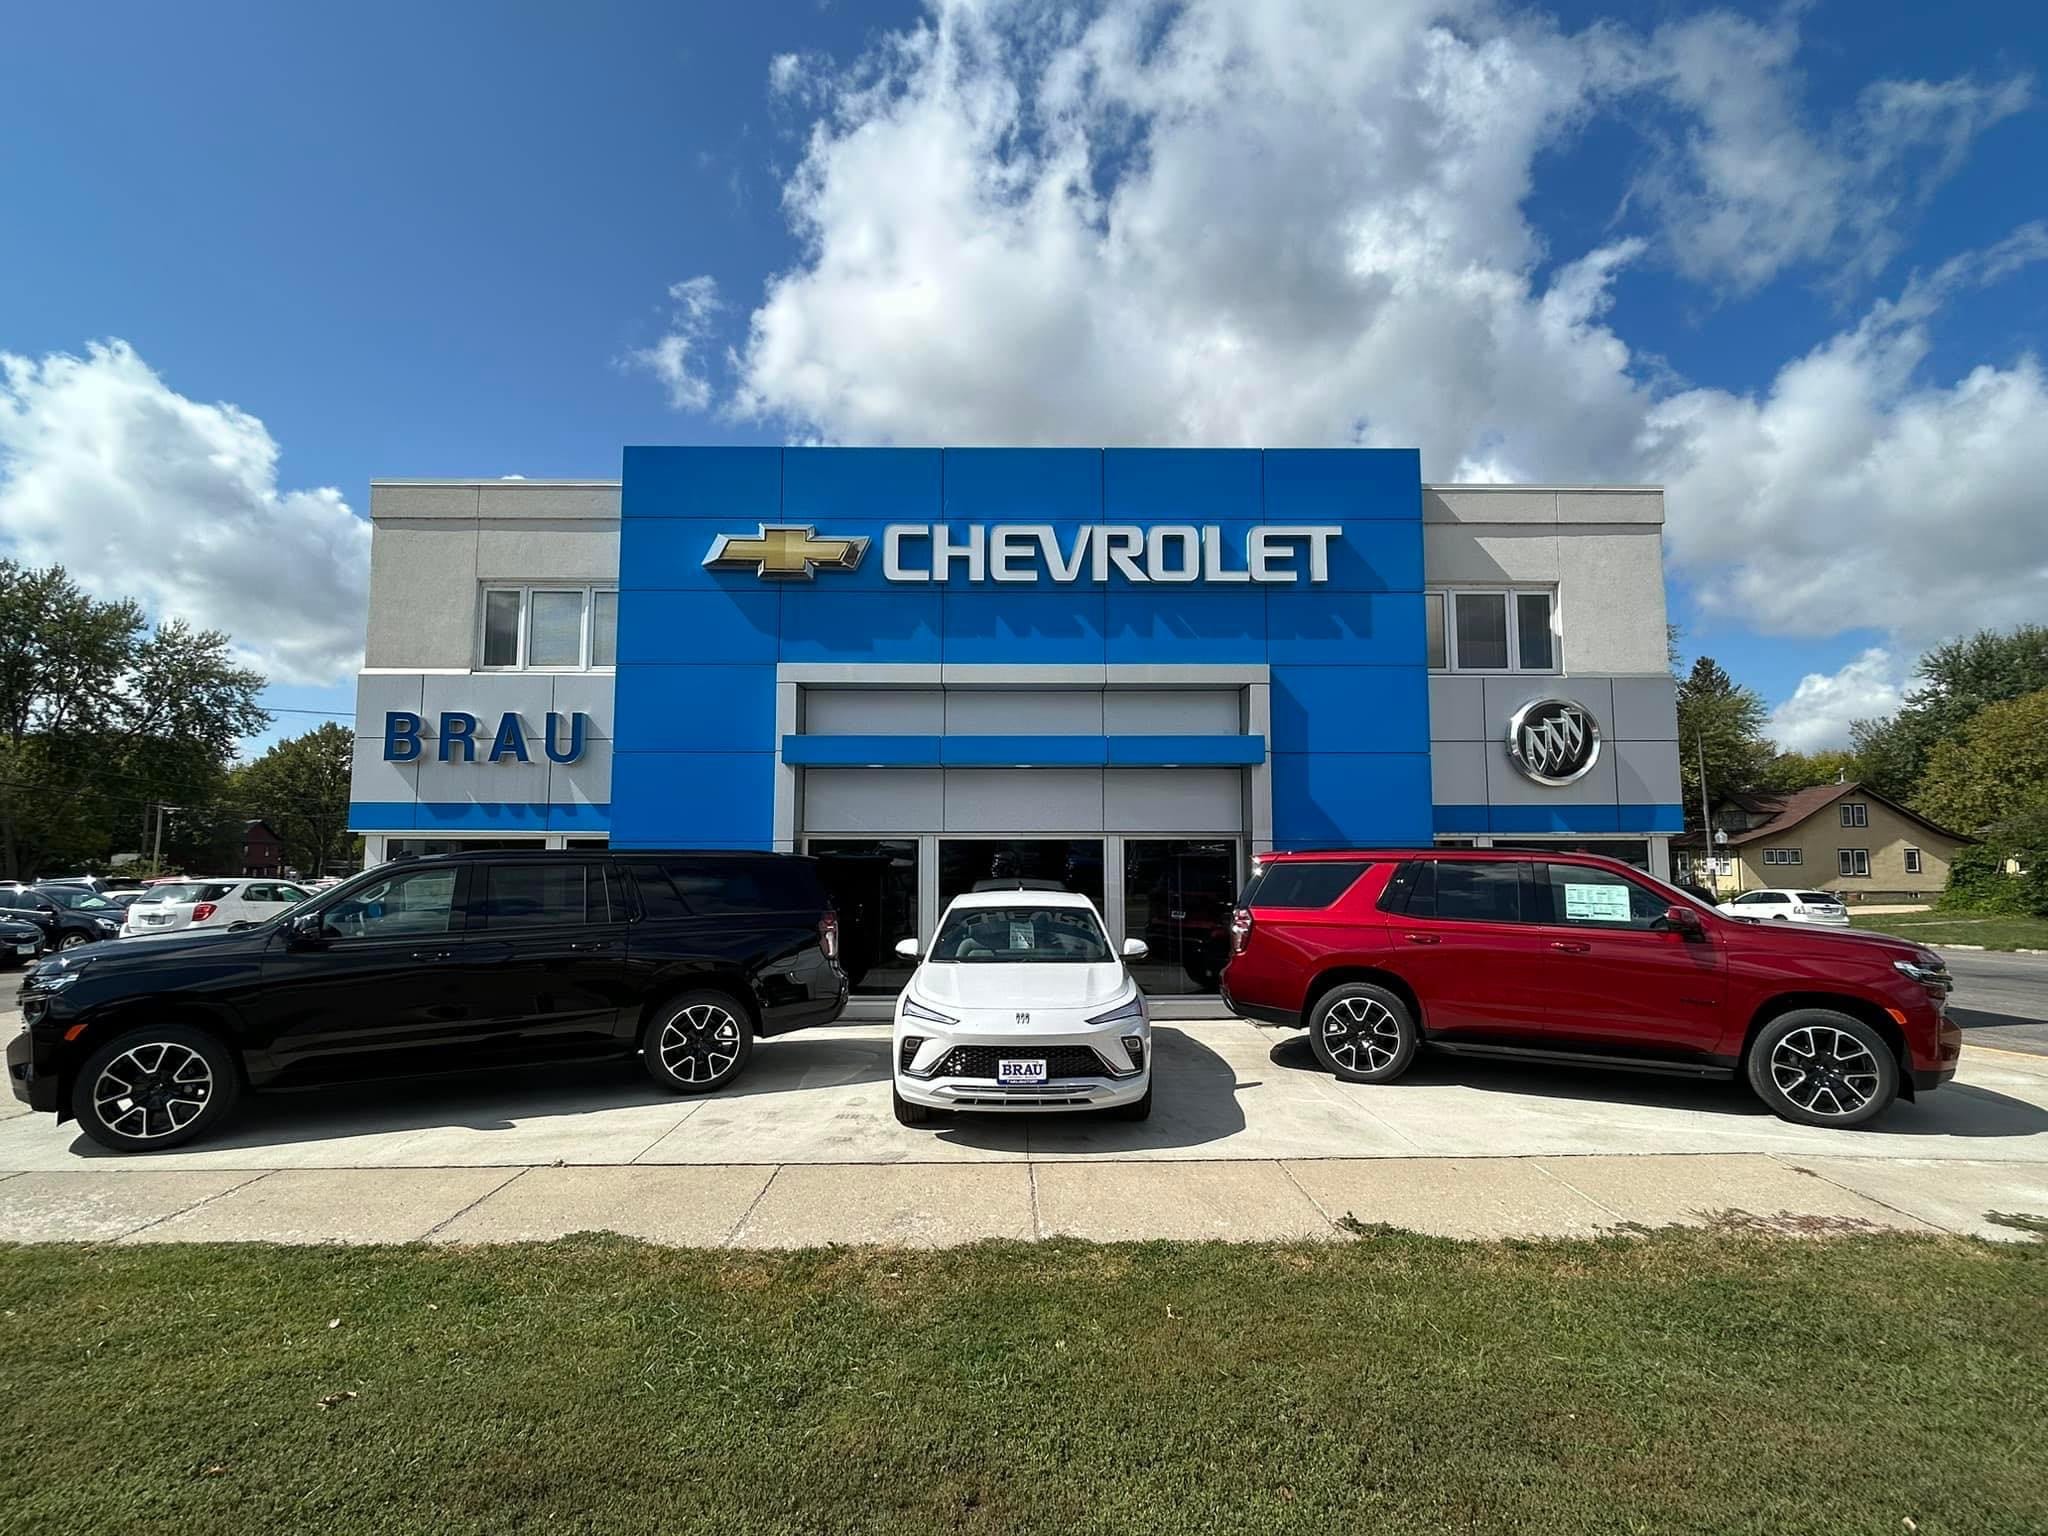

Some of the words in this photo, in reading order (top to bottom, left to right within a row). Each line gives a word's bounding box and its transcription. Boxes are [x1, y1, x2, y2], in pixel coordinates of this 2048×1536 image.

[883, 524, 1343, 582] CHEVROLET
[383, 711, 588, 764] BRAU
[1002, 1063, 1043, 1076] BRAU
